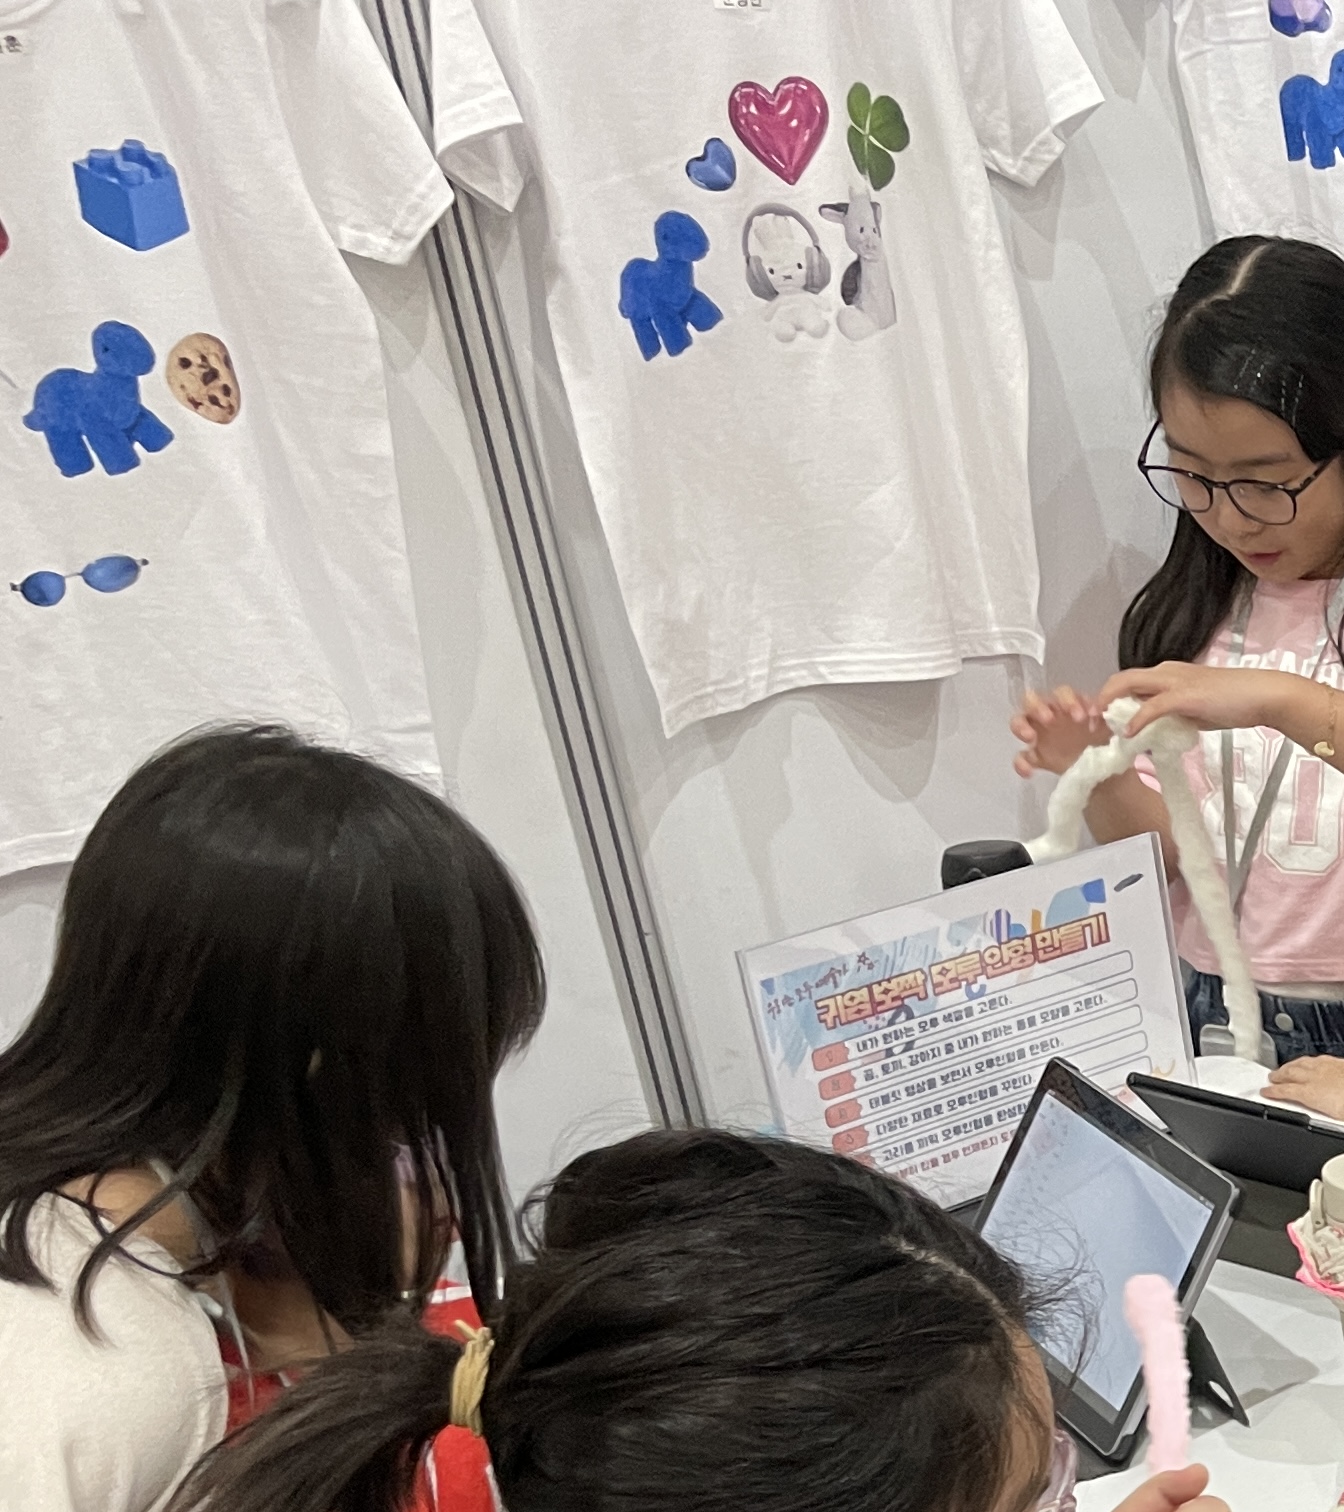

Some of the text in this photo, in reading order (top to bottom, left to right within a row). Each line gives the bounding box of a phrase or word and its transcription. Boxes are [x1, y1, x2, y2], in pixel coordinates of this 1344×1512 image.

[1035, 912, 1110, 962] 만들기
[856, 1036, 878, 1051] 내가
[881, 1025, 914, 1044] 원하는
[976, 994, 1011, 1013] 고른다.
[908, 1046, 940, 1065] 강아지
[957, 1034, 978, 1049] 내가
[1073, 993, 1106, 1012] 고른다.
[939, 1066, 971, 1084] 보면서
[875, 1116, 908, 1134] 다양한
[996, 1102, 1027, 1121] 완성한
